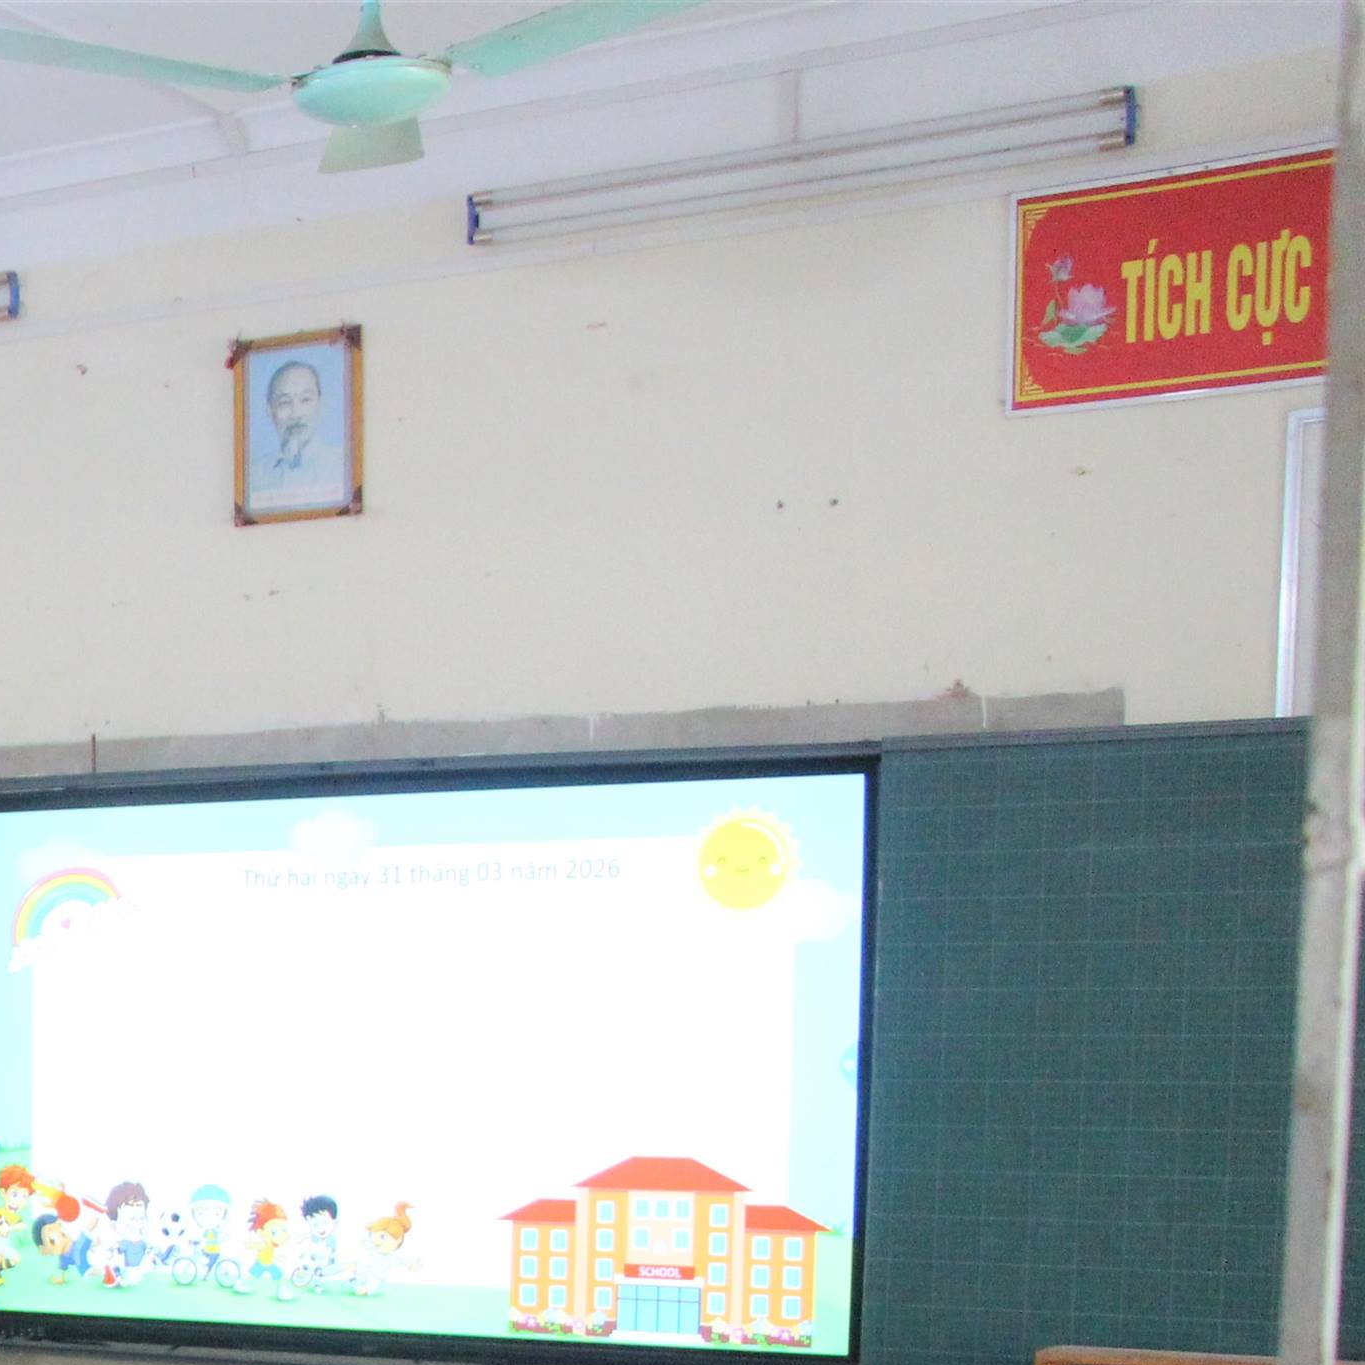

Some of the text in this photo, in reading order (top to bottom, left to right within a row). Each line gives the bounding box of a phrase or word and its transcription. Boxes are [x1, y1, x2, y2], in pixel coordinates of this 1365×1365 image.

[1121, 228, 1312, 346] TÍCH CỰC
[242, 858, 621, 891] Thứ hai ngày 31 tháng 03 năm 2026
[638, 1265, 681, 1278] SCHOOL
